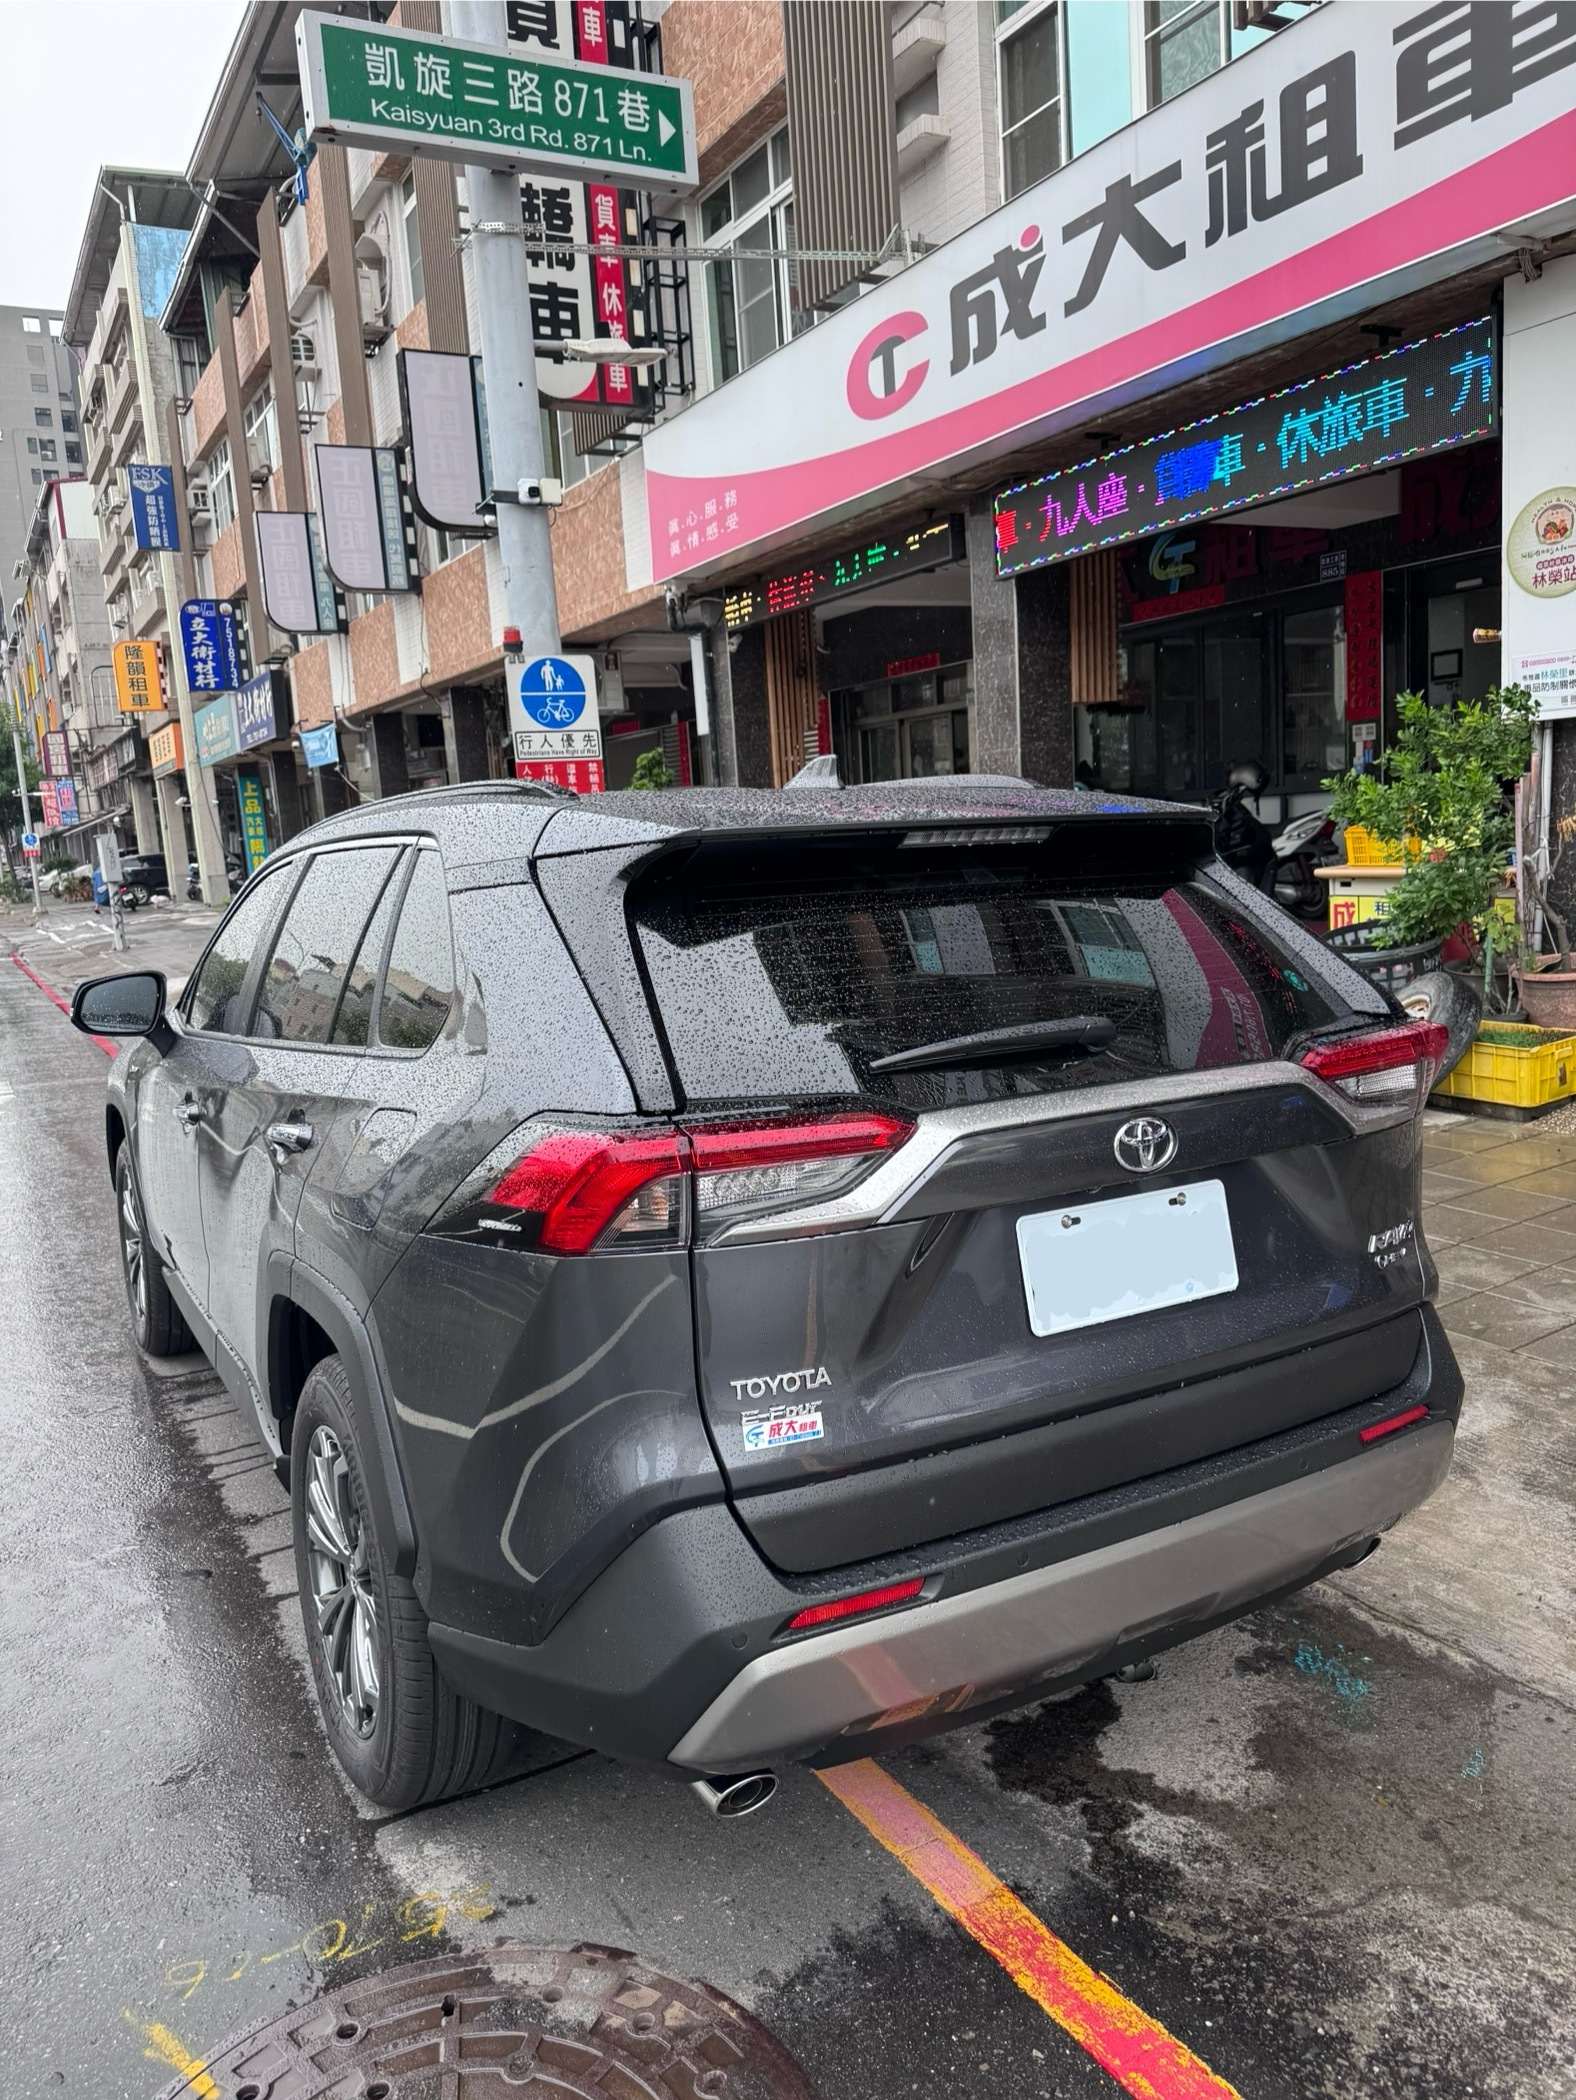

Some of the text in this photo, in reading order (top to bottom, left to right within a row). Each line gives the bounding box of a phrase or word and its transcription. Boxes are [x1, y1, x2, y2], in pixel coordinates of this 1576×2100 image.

[364, 43, 650, 133] 凱旋三路871巷
[371, 99, 653, 162] Kaisyuan 3rd Rd. 871 Ln.
[949, 0, 1576, 376] 成大租車
[1276, 378, 1410, 470] 休旅車
[519, 733, 597, 749] 行人優先
[730, 1366, 832, 1400] TOYOTA
